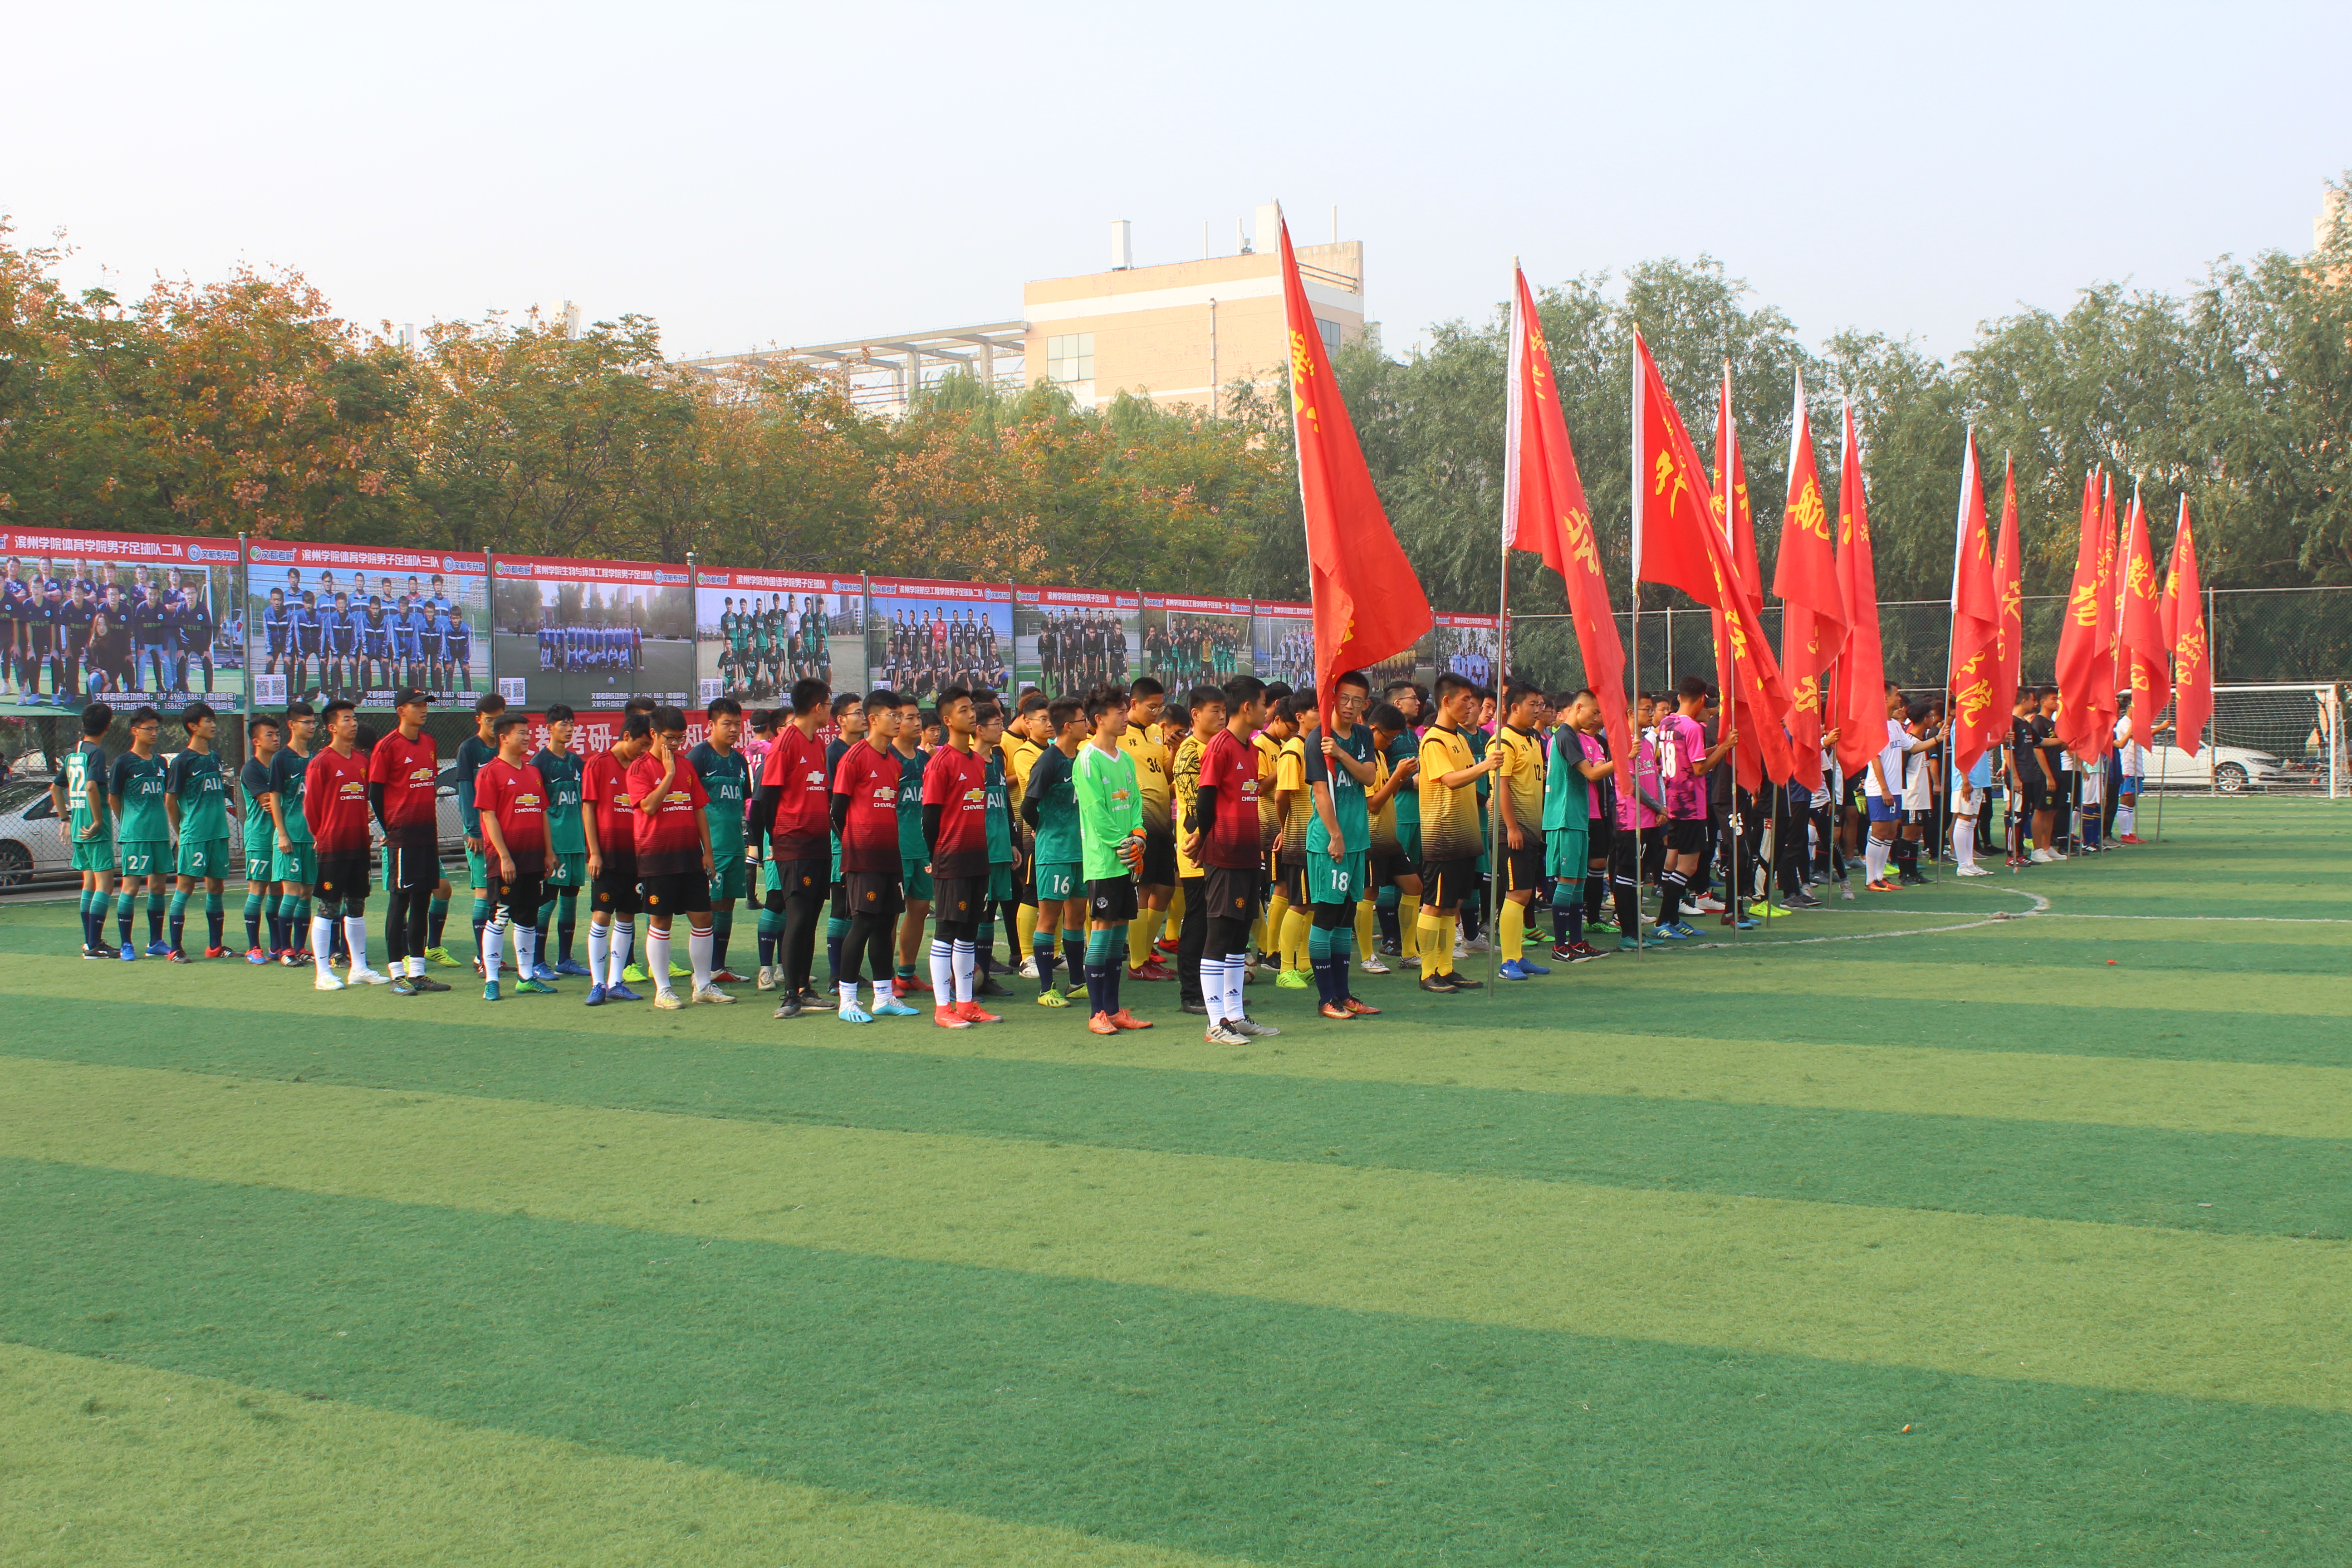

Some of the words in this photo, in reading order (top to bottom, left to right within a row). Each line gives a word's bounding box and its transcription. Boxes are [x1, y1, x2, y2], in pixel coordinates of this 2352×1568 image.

[15, 535, 183, 557] 滨州学院体育学院男子足球队二队
[201, 549, 239, 561] 文航专升本
[262, 549, 295, 562] 文都考研
[301, 549, 439, 568] 滨州学院体育学院男子足球队三队
[454, 561, 485, 572] 文航专升本
[504, 564, 532, 575] 文都考研
[534, 565, 654, 580] 滨州学院生物与环境工程学院男子足球队
[662, 573, 689, 583] 文航专升本
[705, 574, 729, 585] 文都考研
[736, 574, 827, 589] 滨州学院外国语学院男子足球队
[899, 585, 983, 597] 滨州学院航空工程学院男子足球队二队
[1147, 757, 1161, 773] 36
[1659, 741, 1677, 778] 18
[1336, 769, 1352, 787] AI
[1534, 764, 1542, 782] 12
[68, 765, 87, 797] 22
[141, 781, 163, 794] AIA
[558, 790, 578, 806] AIA
[720, 784, 742, 800] AIA
[127, 855, 150, 870] 27
[250, 858, 270, 875] 77
[289, 858, 299, 872] 5
[1053, 874, 1070, 895] 16
[1331, 869, 1349, 892] 18
